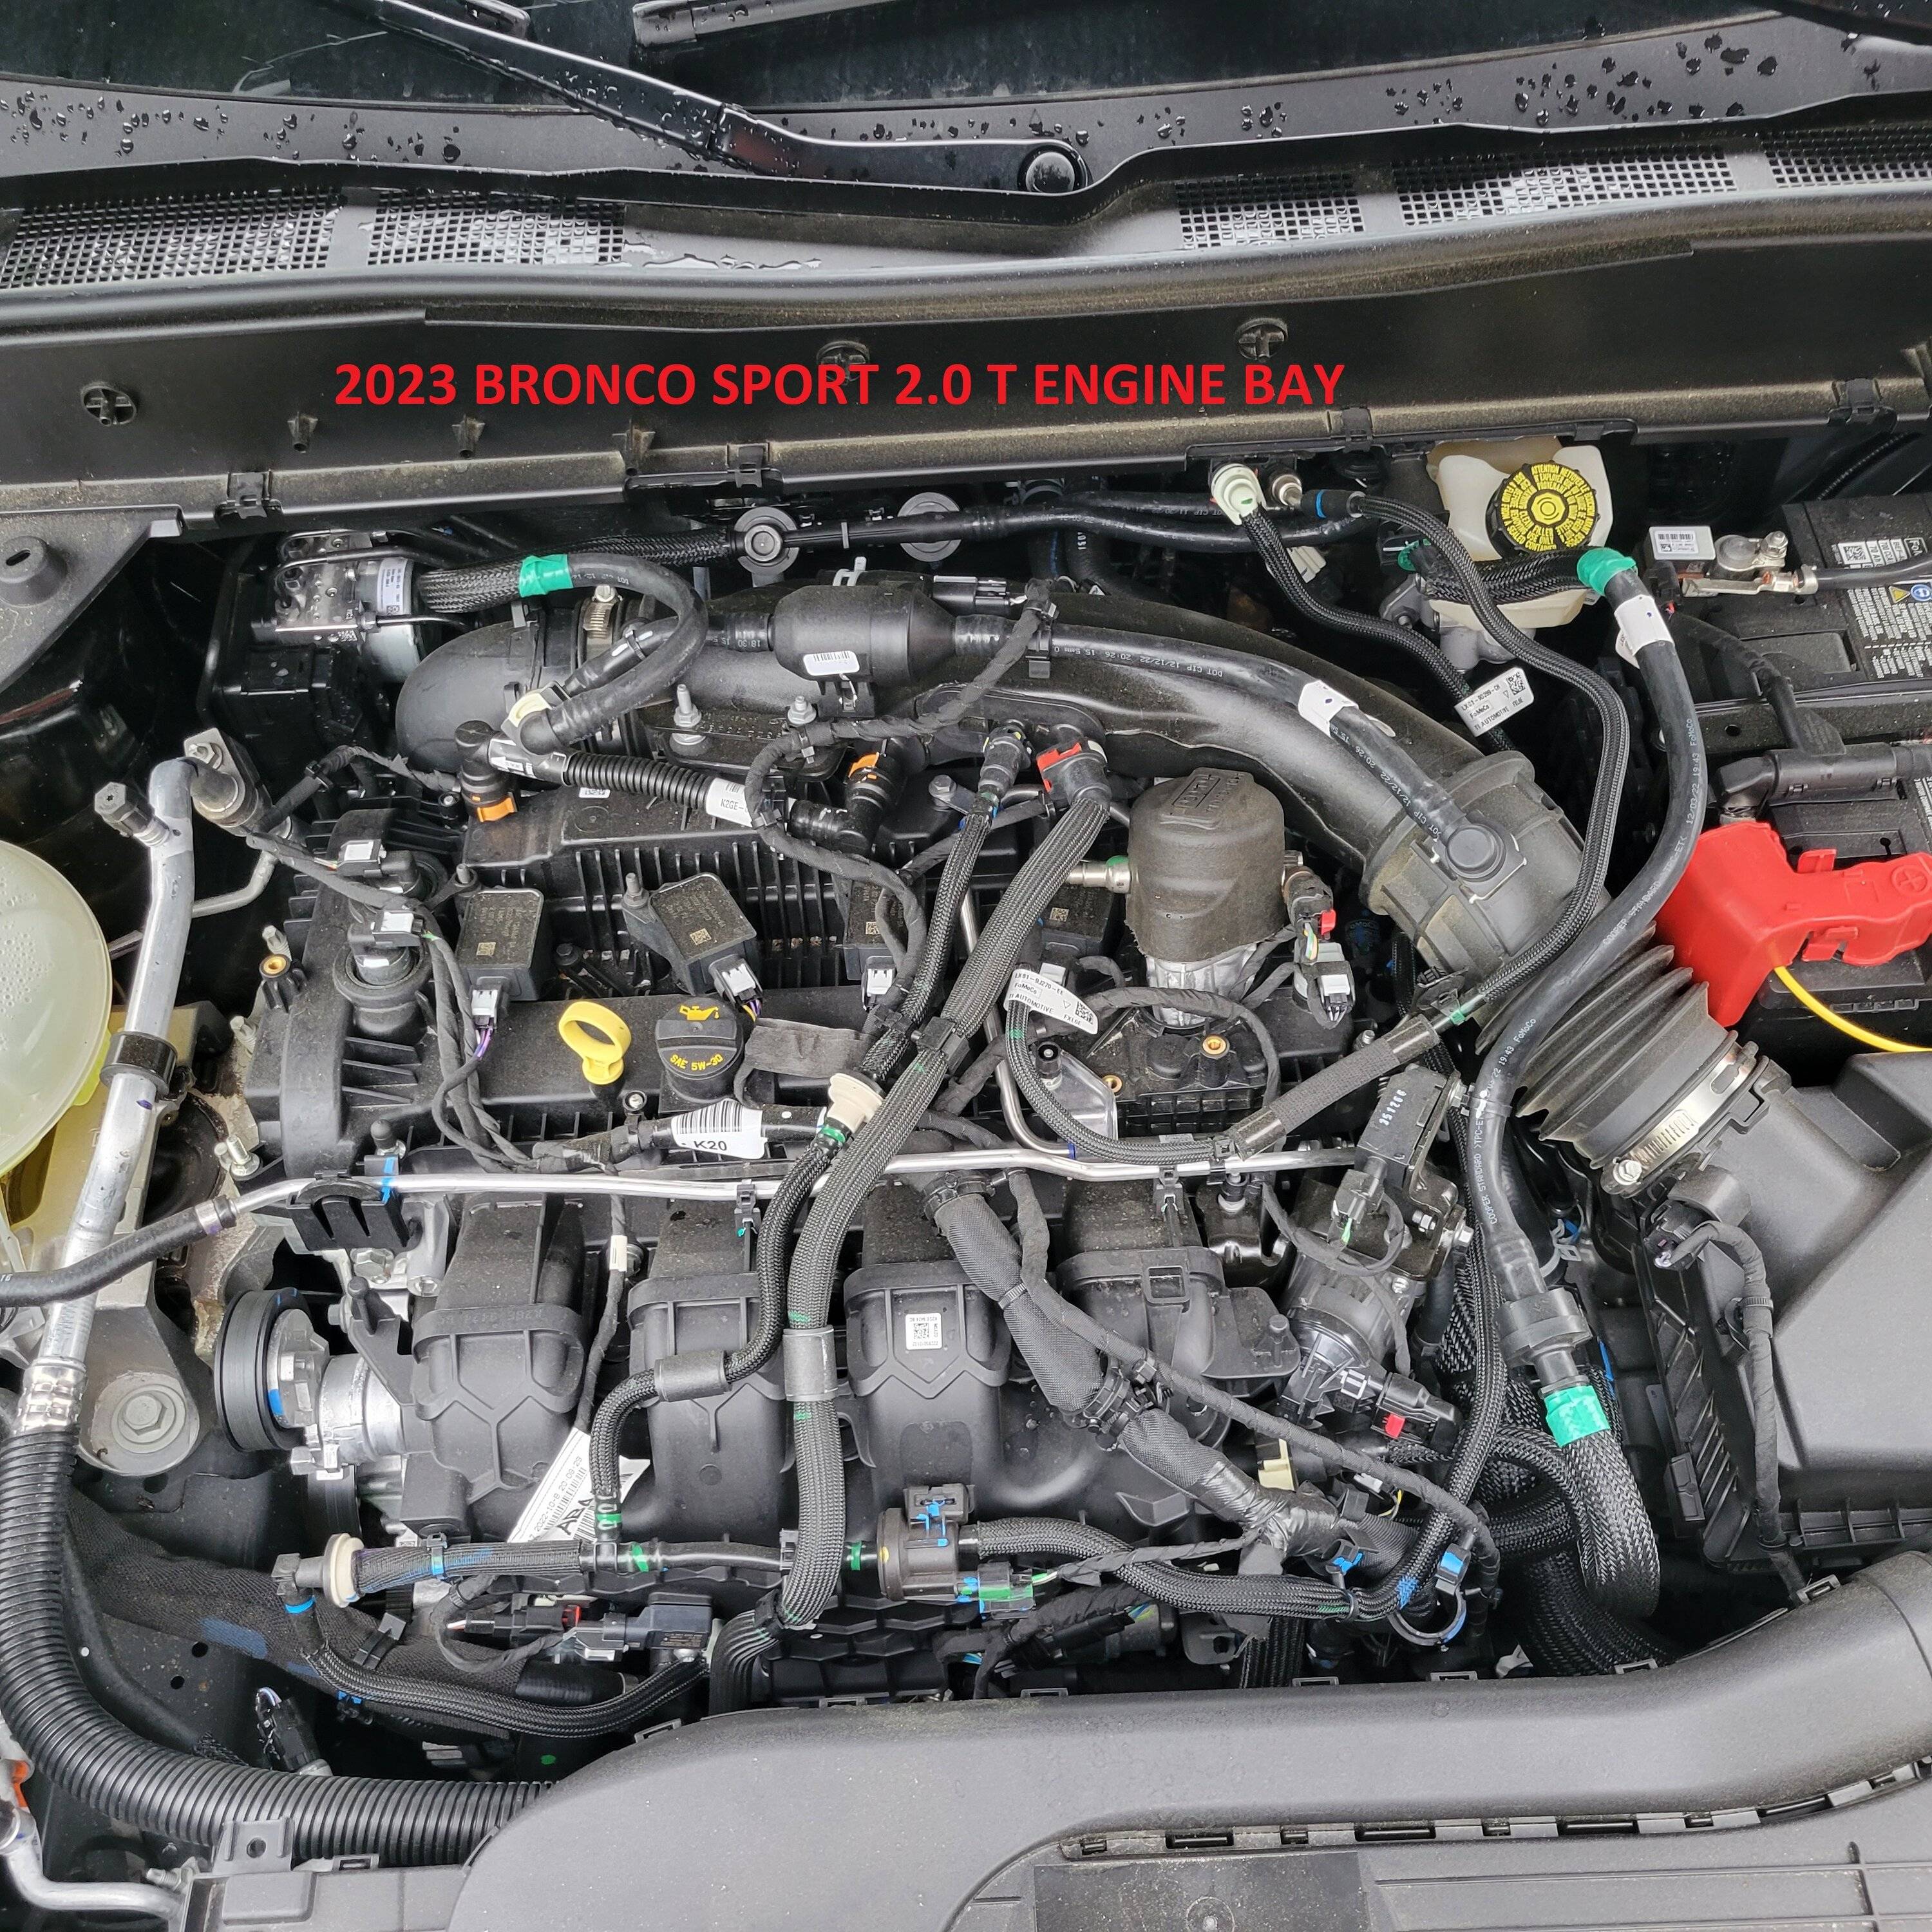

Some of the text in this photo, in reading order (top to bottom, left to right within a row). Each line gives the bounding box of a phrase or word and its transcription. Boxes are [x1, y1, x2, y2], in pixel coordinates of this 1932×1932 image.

[1501, 504, 1511, 520] FROM
[1507, 526, 1526, 544] SEALED
[1520, 511, 1534, 529] CLEAN
[1527, 530, 1539, 543] USE
[1539, 535, 1553, 545] ONLY
[1105, 650, 1132, 661] 20:26
[1139, 656, 1180, 668] 12/12/22
[1207, 668, 1223, 677] DOT
[1469, 705, 1490, 719] FoMoCo
[1481, 706, 1510, 727] AUTOMOTIVE
[1686, 718, 1698, 746] FoMoCo
[1356, 746, 1376, 768] 20:26
[1692, 752, 1701, 777] 19:43
[1380, 772, 1412, 807] 12/12/22
[1685, 783, 1700, 824] 12/03/22
[1628, 880, 1661, 916] STANDARD
[1602, 918, 1629, 945] COOPER
[1014, 982, 1037, 995] FoMoCo
[1014, 994, 1055, 1014] AUTOMOTIVE
[1513, 1018, 1537, 1043] FoMoCo
[670, 1054, 723, 1071] SAE 5W-30
[1499, 1045, 1515, 1066] 19:43
[694, 1141, 727, 1151] K20
[1474, 1153, 1486, 1193] STANDARD
[1482, 1194, 1497, 1224] COOPER
